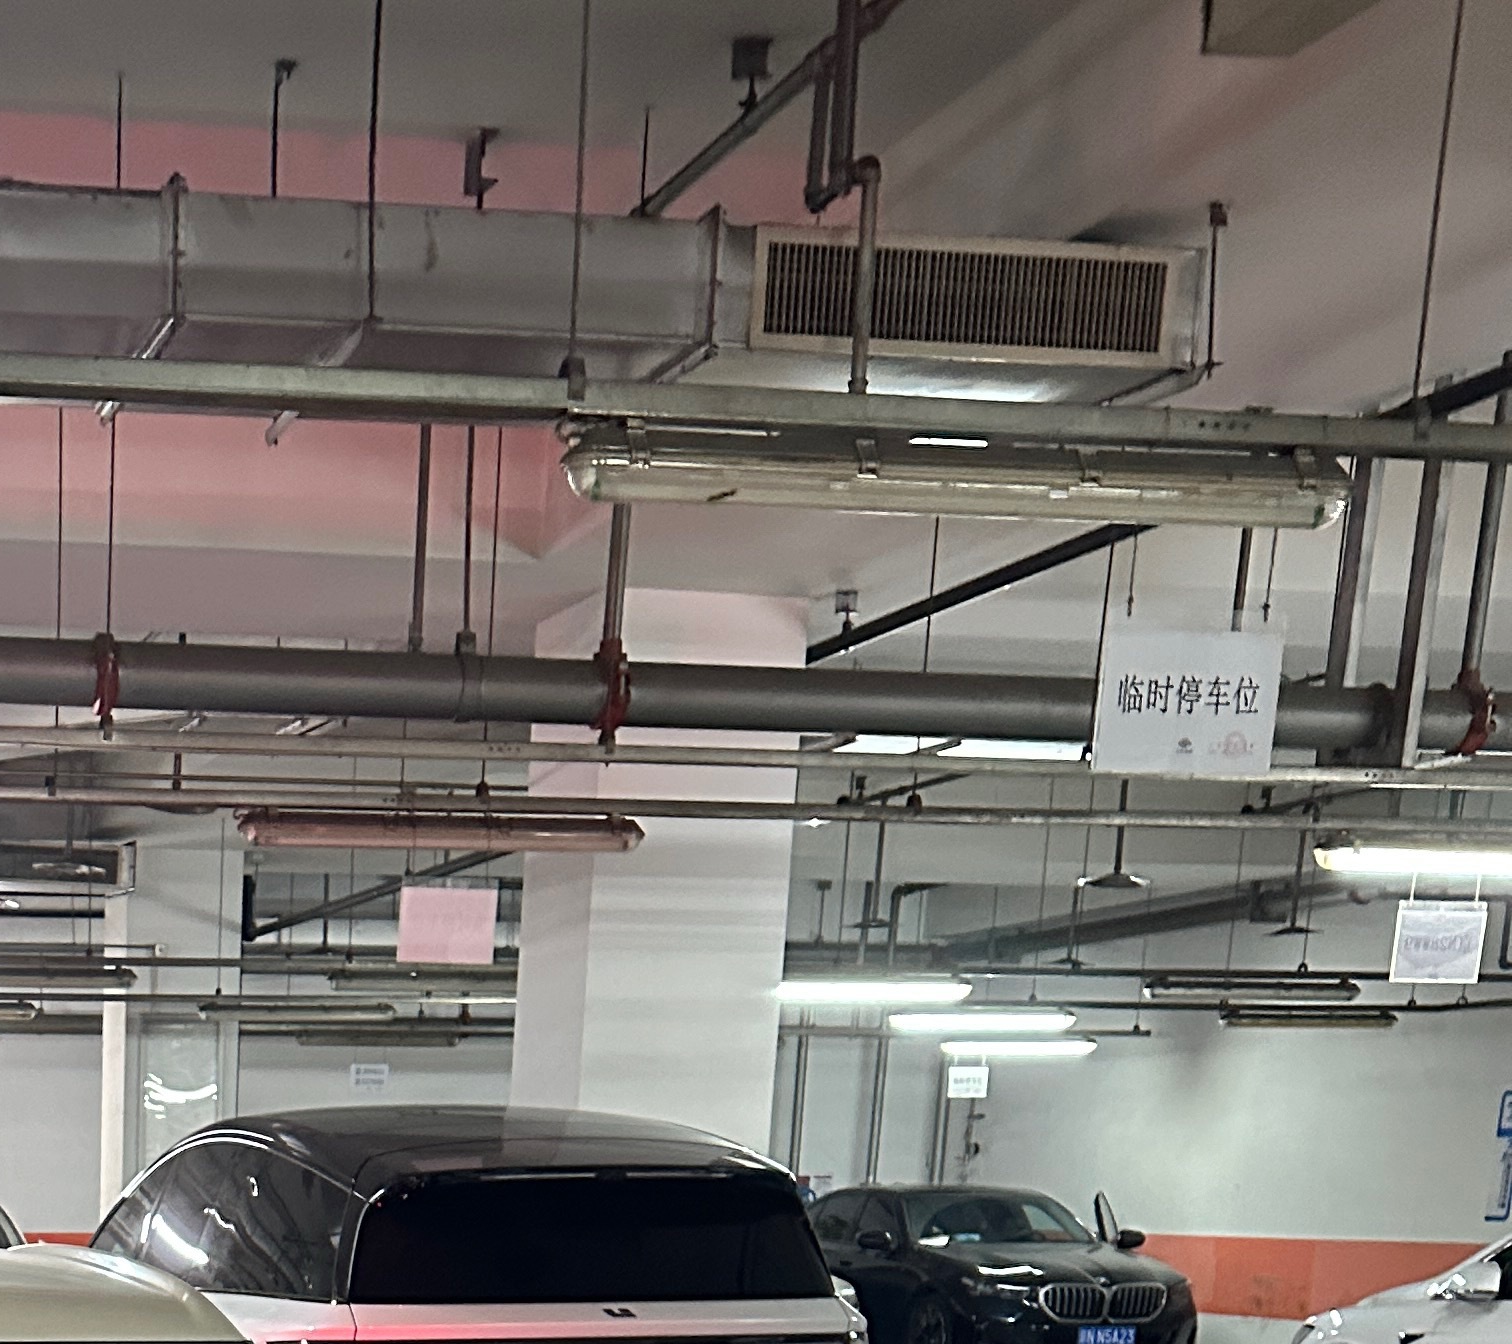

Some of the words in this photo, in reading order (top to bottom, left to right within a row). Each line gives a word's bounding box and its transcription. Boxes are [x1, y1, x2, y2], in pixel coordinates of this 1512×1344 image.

[1117, 673, 1260, 716] 临时停车位
